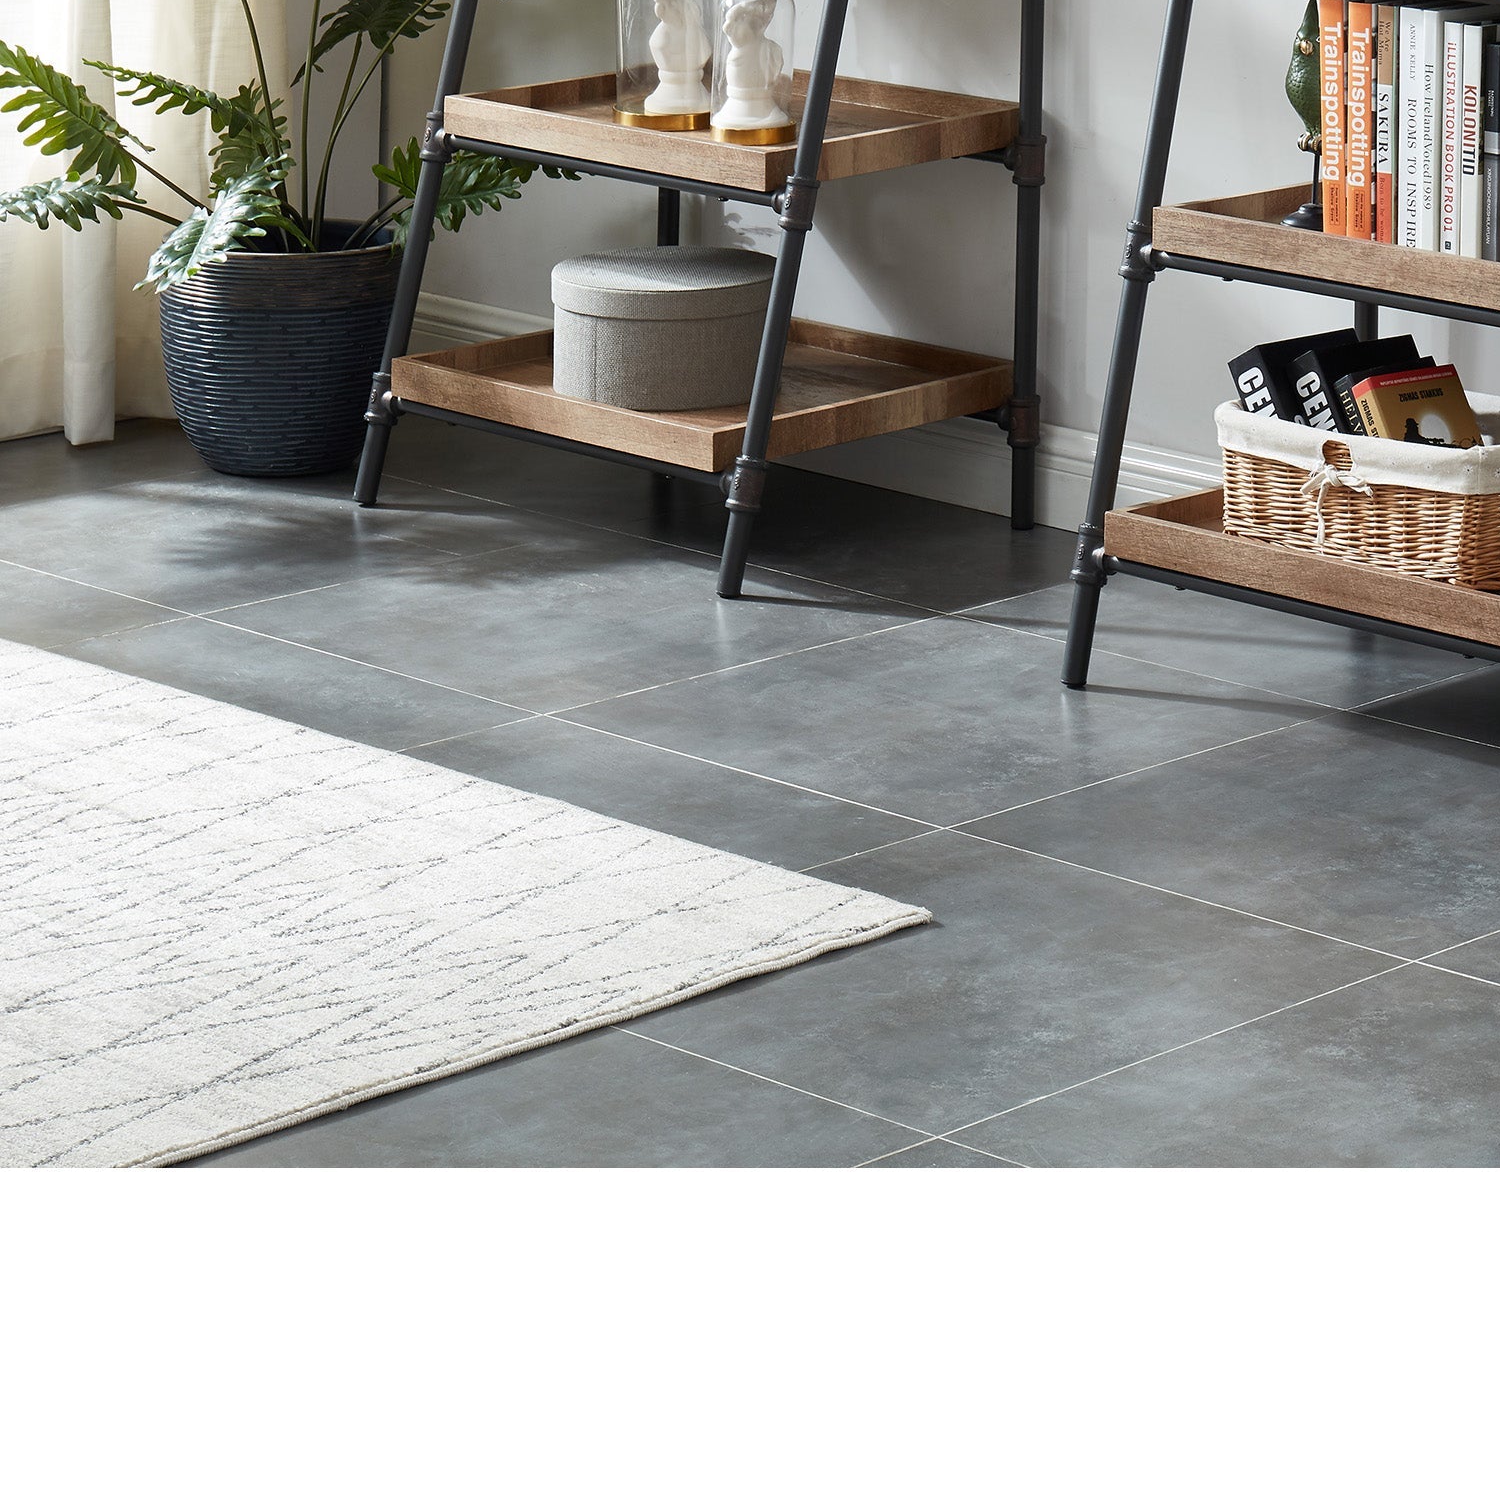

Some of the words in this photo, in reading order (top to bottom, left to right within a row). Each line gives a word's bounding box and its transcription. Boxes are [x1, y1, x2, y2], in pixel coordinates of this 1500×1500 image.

[1385, 21, 1391, 35] We
[1409, 23, 1417, 50] ANNIE
[1424, 63, 1434, 92] How
[1321, 22, 1341, 182] Trainspotting
[1348, 28, 1370, 187] Trainspotting
[1379, 92, 1389, 165] SAKURA
[1407, 98, 1417, 149] ROOMS
[1407, 156, 1417, 174] TO
[1444, 144, 1455, 183] BOOK
[1444, 186, 1454, 214] PRO
[1443, 217, 1454, 232] 01
[1296, 371, 1339, 434] CEN
[1339, 390, 1365, 436] HELV
